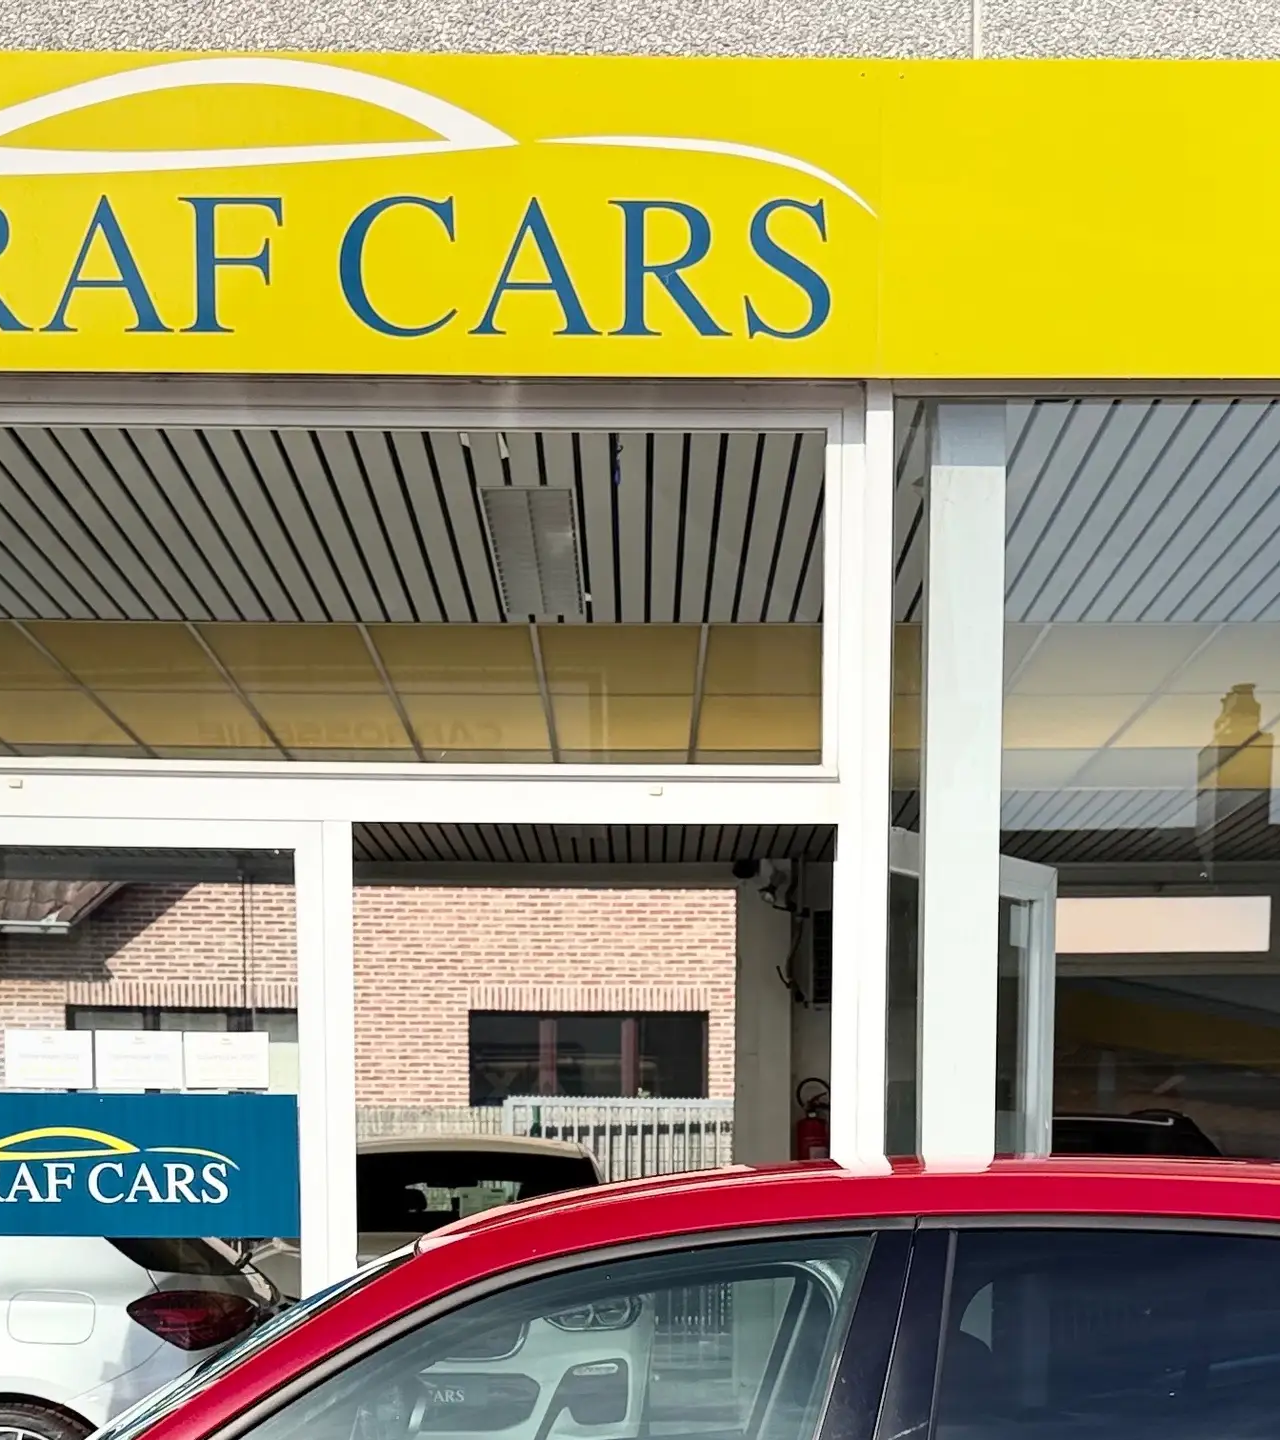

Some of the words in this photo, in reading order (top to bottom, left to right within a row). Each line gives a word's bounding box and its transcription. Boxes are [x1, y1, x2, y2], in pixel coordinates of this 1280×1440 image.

[338, 195, 832, 341] CARS
[87, 1161, 229, 1205] CARS
[428, 1388, 466, 1404] ARS
